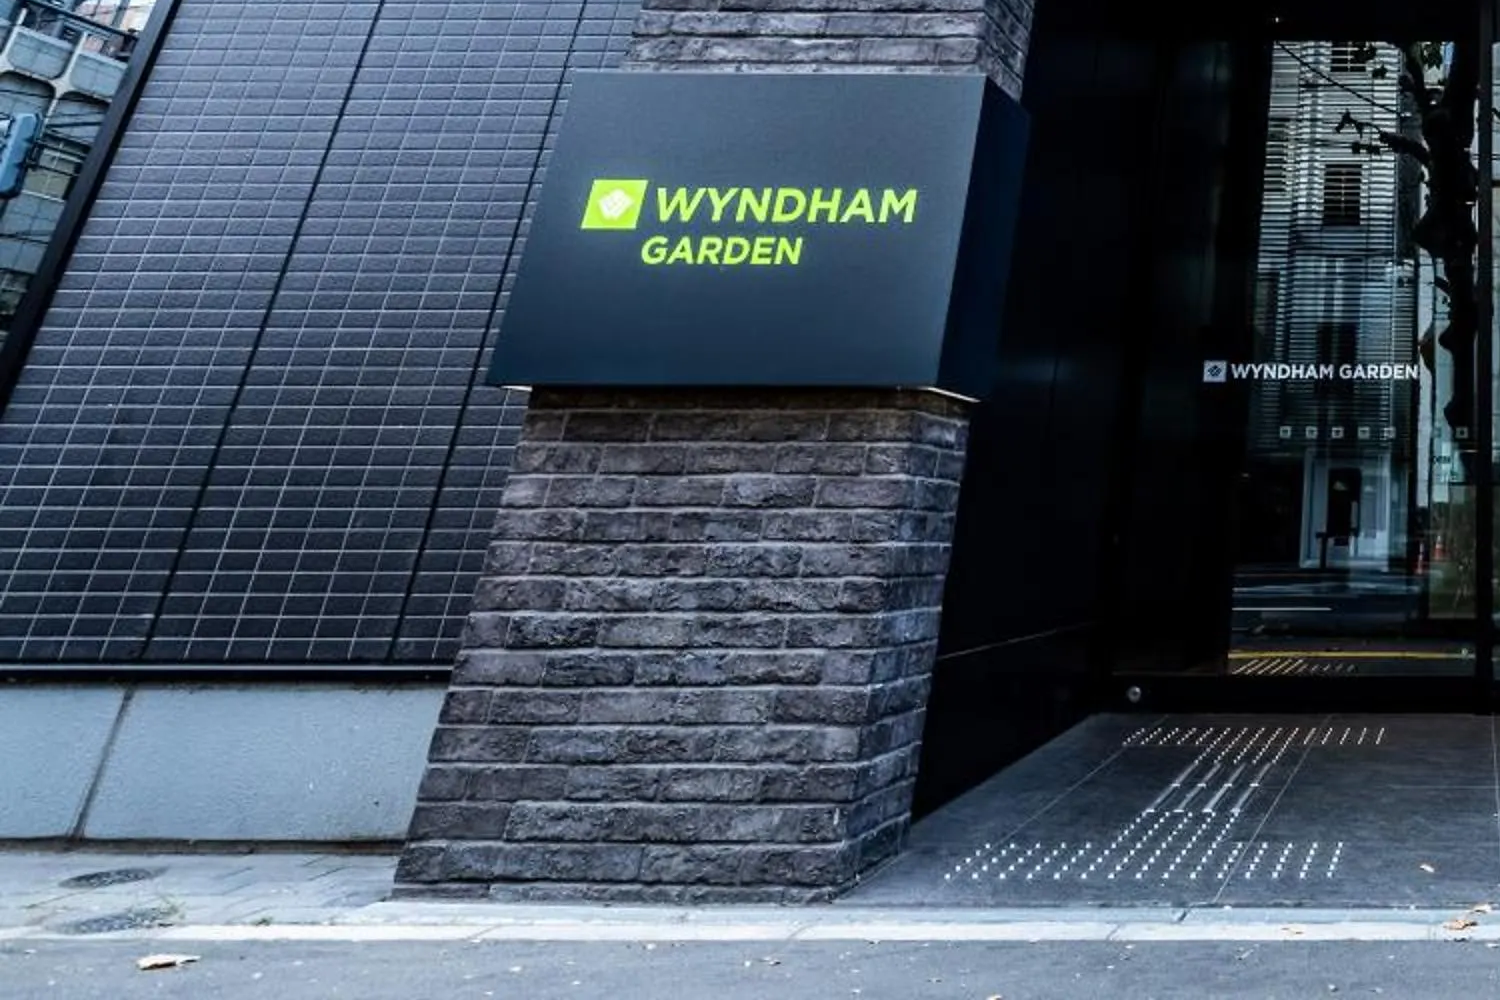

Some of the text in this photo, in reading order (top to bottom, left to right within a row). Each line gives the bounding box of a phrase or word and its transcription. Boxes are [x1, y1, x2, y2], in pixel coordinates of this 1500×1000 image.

[655, 187, 918, 223] WYNDHAM
[641, 236, 802, 265] GARDEN
[1230, 362, 1419, 380] WYNDHAM GARDEN
